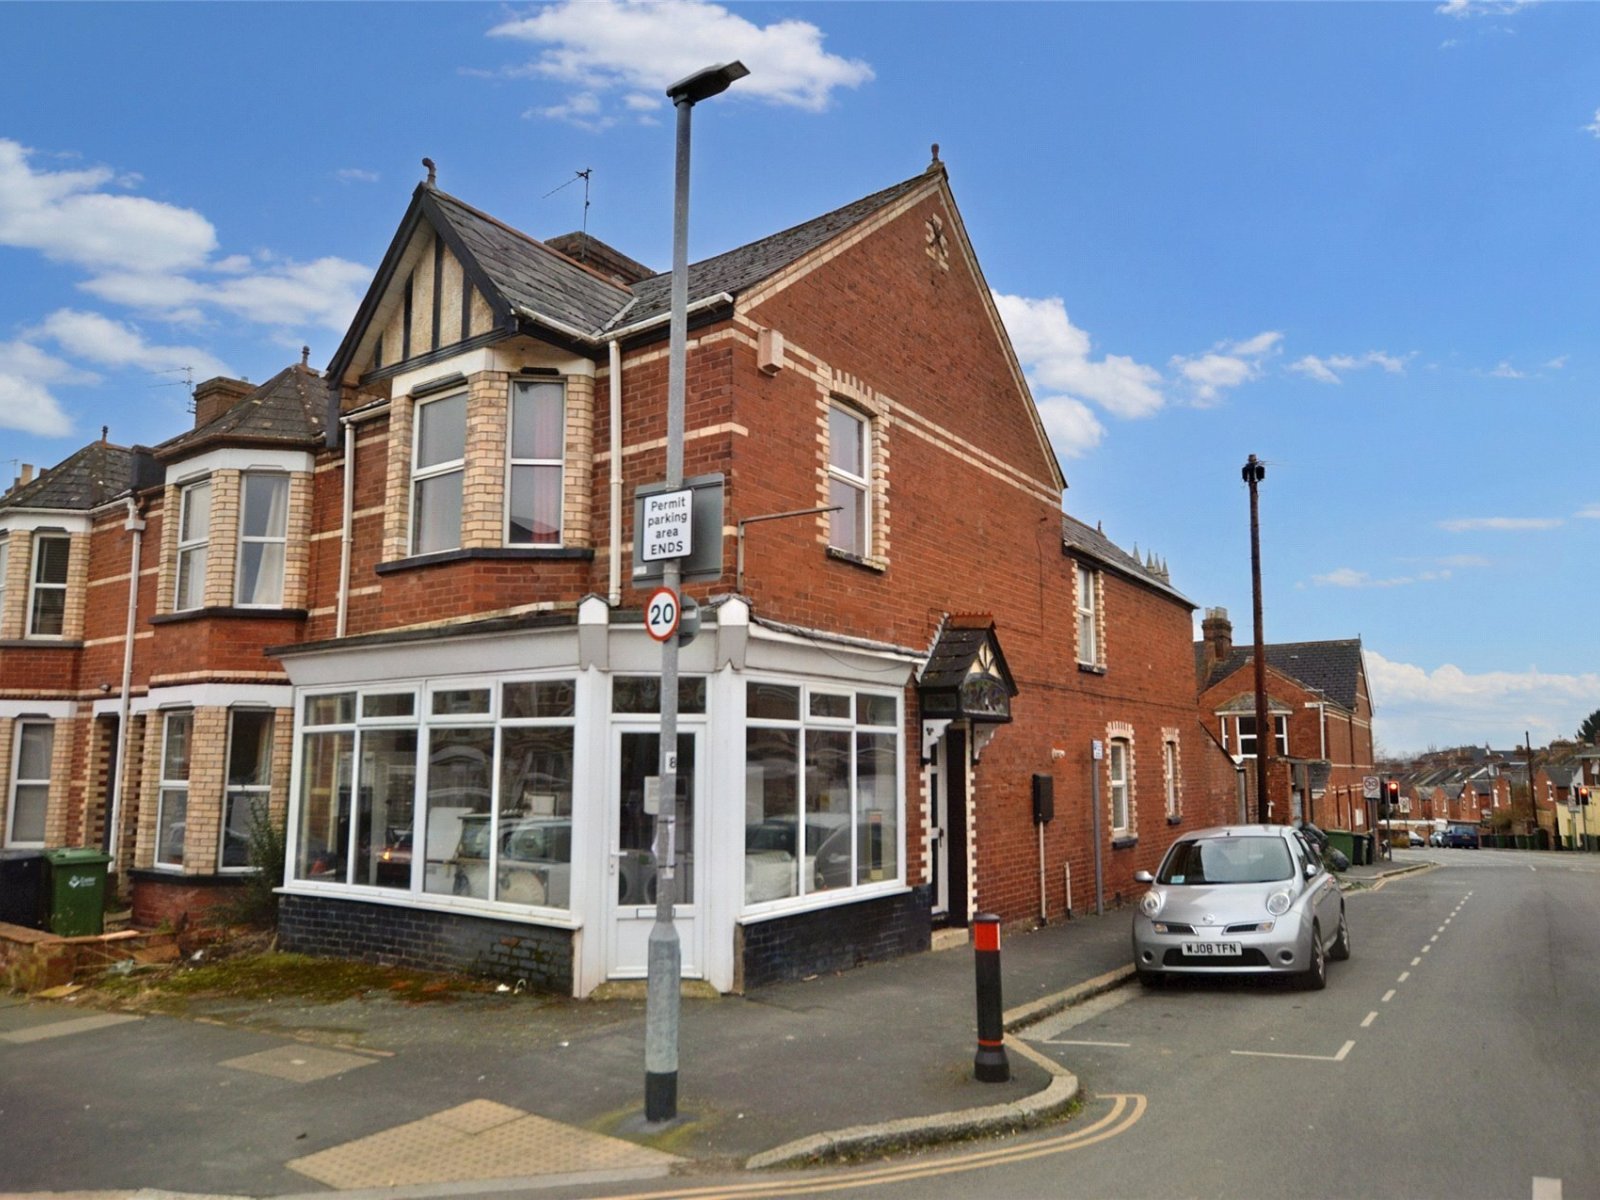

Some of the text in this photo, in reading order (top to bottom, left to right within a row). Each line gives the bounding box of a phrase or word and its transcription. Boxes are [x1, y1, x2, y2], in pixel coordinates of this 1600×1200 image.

[651, 497, 686, 511] Permit
[648, 512, 687, 528] parking
[655, 528, 678, 539] area
[651, 541, 683, 555] ENDS
[650, 603, 674, 625] 20
[1186, 943, 1237, 954] WJ08 TFN
